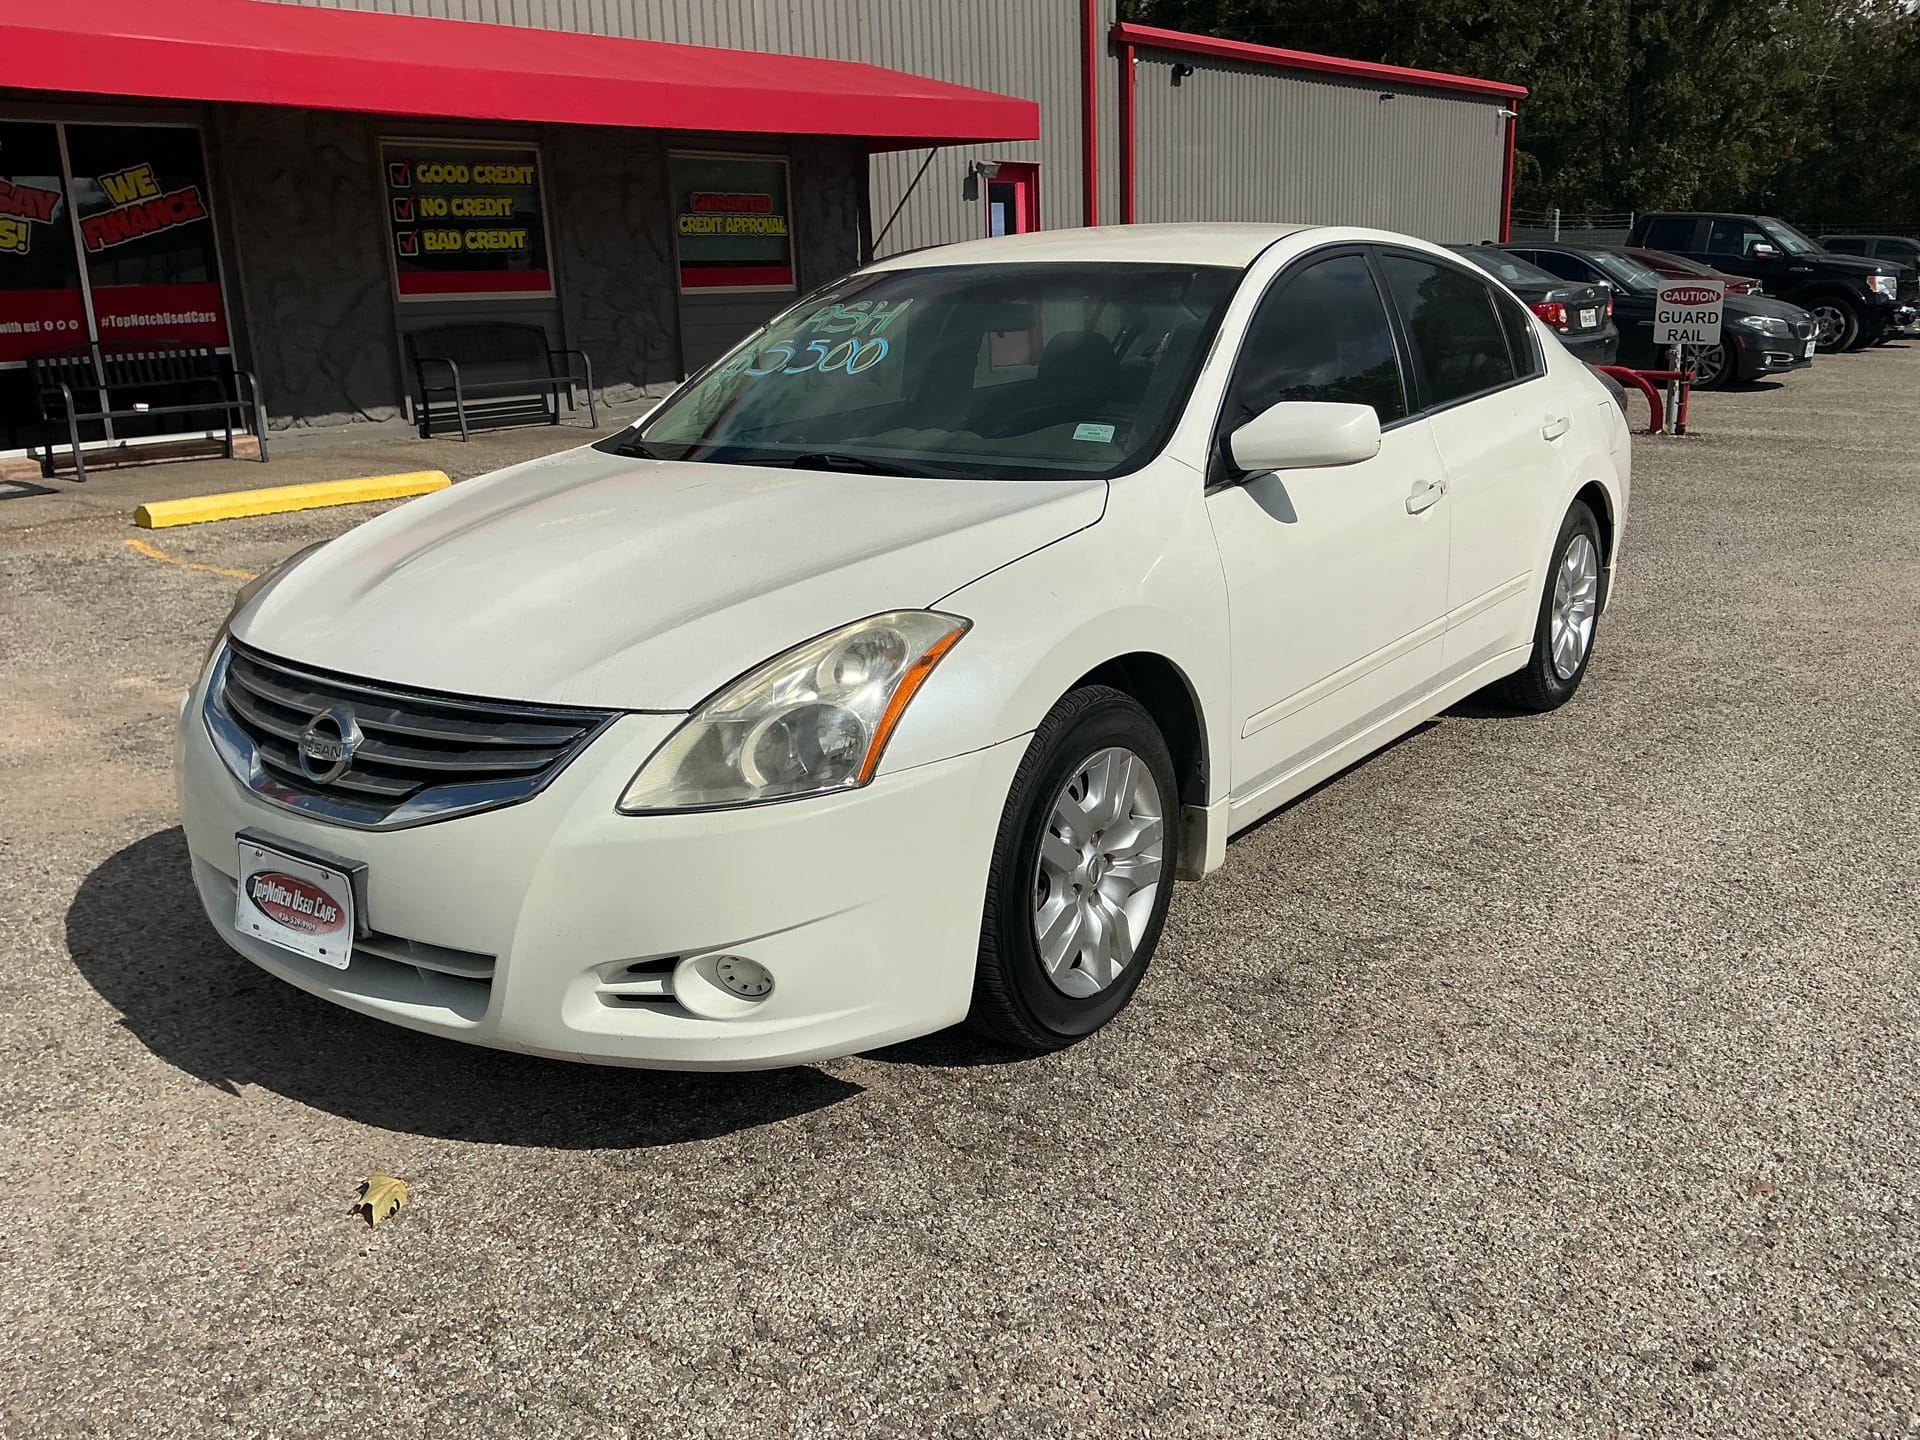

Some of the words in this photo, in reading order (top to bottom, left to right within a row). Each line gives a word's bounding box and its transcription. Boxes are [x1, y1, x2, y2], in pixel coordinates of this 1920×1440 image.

[416, 164, 470, 184] GOOD
[473, 165, 534, 184] CREDIT
[102, 164, 158, 204] WE
[420, 198, 448, 217] NO
[451, 198, 512, 217] CREDIT
[81, 188, 206, 250] FINANCE
[679, 216, 723, 233] CREDIT
[725, 217, 786, 234] APPROVAL
[423, 231, 462, 250] BAD
[464, 230, 526, 250] CREDIT
[1663, 291, 1718, 301] CAUTION
[101, 311, 216, 328] #TopNotchUsedCars
[1658, 311, 1719, 325] GUARD
[1667, 329, 1706, 342] RAIL
[292, 889, 314, 914] USED
[313, 896, 337, 922] CARS
